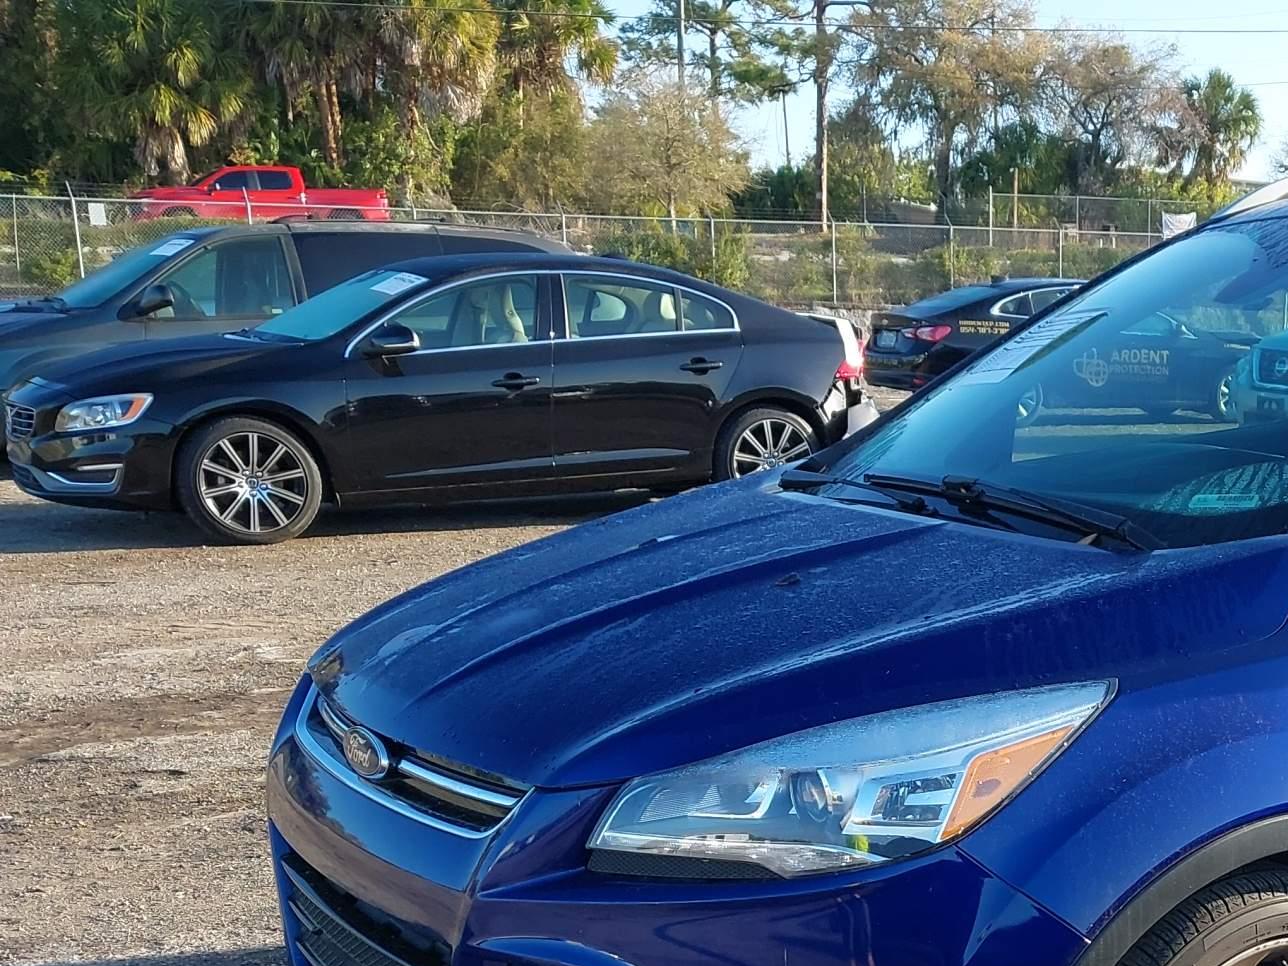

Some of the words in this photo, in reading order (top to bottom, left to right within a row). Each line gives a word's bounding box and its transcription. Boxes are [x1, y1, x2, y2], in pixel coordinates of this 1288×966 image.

[1111, 348, 1169, 365] ARDENT
[1109, 364, 1169, 376] PROTECTION
[347, 733, 372, 768] Ford
